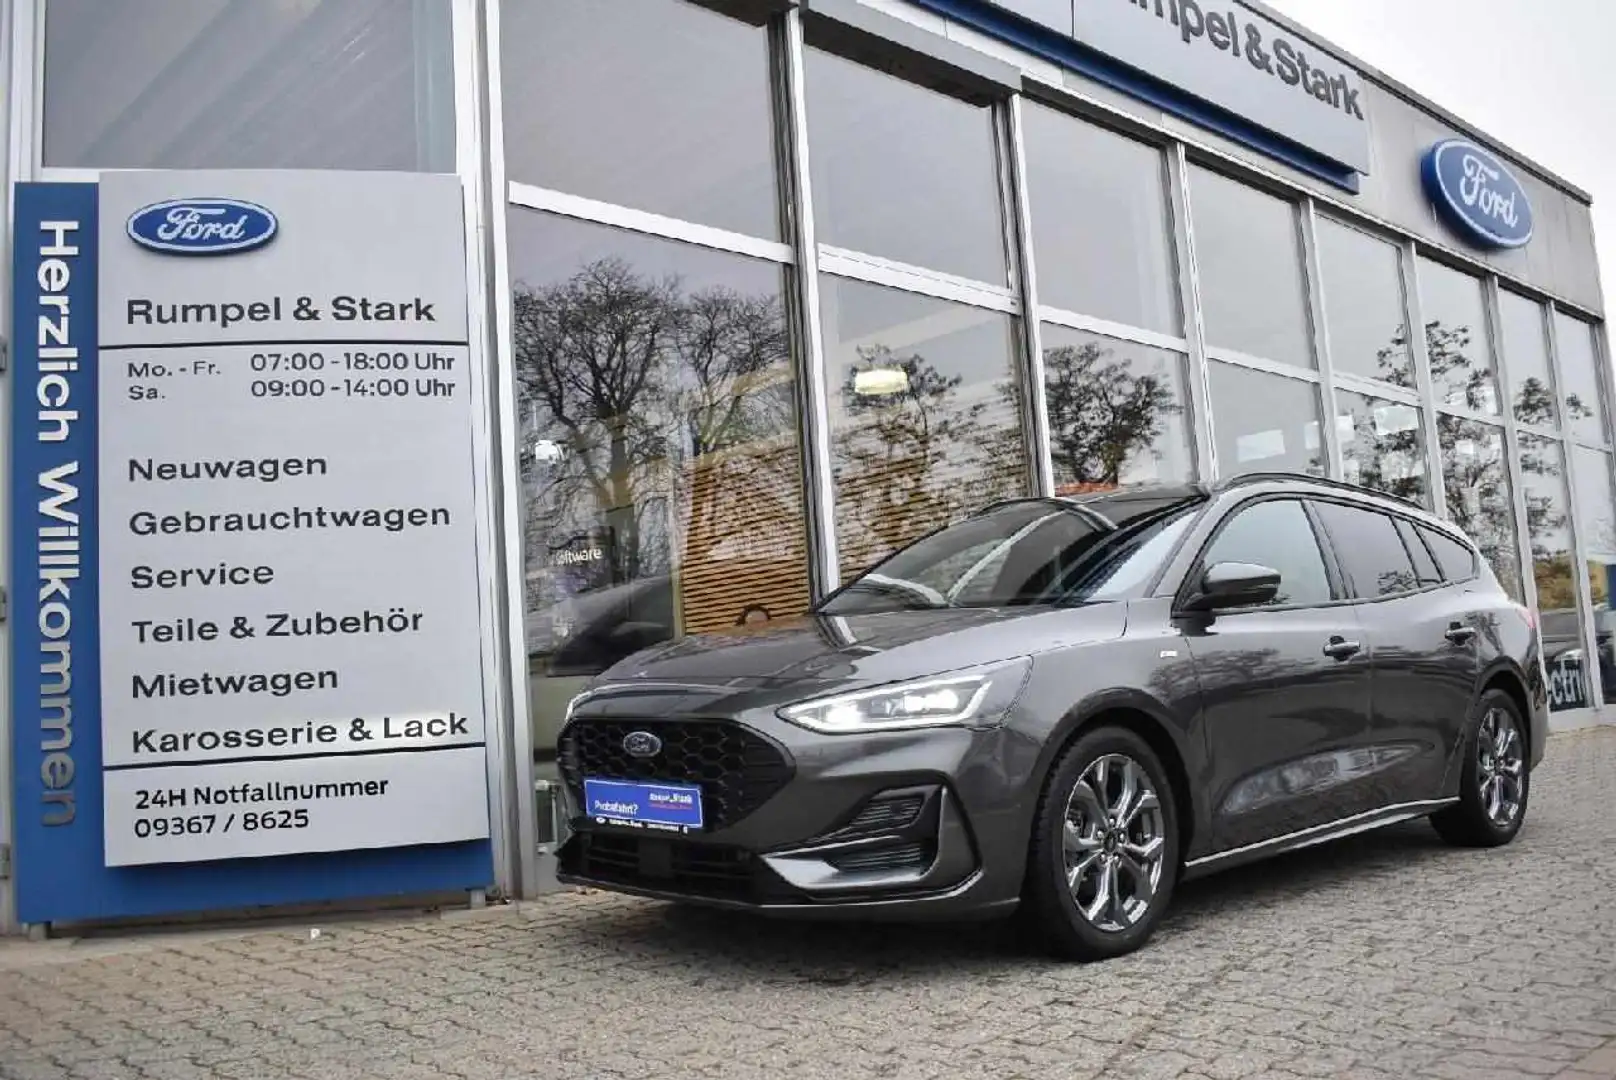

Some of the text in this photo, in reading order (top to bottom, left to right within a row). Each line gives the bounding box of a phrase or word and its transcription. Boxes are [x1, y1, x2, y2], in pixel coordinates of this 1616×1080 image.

[1129, 0, 1365, 121] mpel & Stark
[1459, 152, 1519, 229] Ford
[156, 207, 246, 241] Ford
[128, 296, 435, 328] Rumpel & Stark
[128, 363, 172, 377] Mo.
[194, 361, 220, 374] Fr.
[251, 353, 324, 371] 07:00
[415, 353, 455, 370] Uhr
[129, 386, 165, 400] Sa.
[251, 379, 324, 396] 09:00
[416, 379, 455, 396] Uhr
[129, 459, 326, 482] Neuwagen
[37, 220, 80, 827] Herzlich Willkommen
[130, 507, 449, 535] Gebrauchtwagen
[132, 563, 273, 588] Service
[132, 608, 422, 643] Teile & Zubehör
[133, 671, 337, 698] Mietwagen
[132, 713, 468, 754] Karosserie & Lack
[136, 779, 389, 809] 24H Notfallnummer
[135, 809, 308, 838] 09367 / 8625
